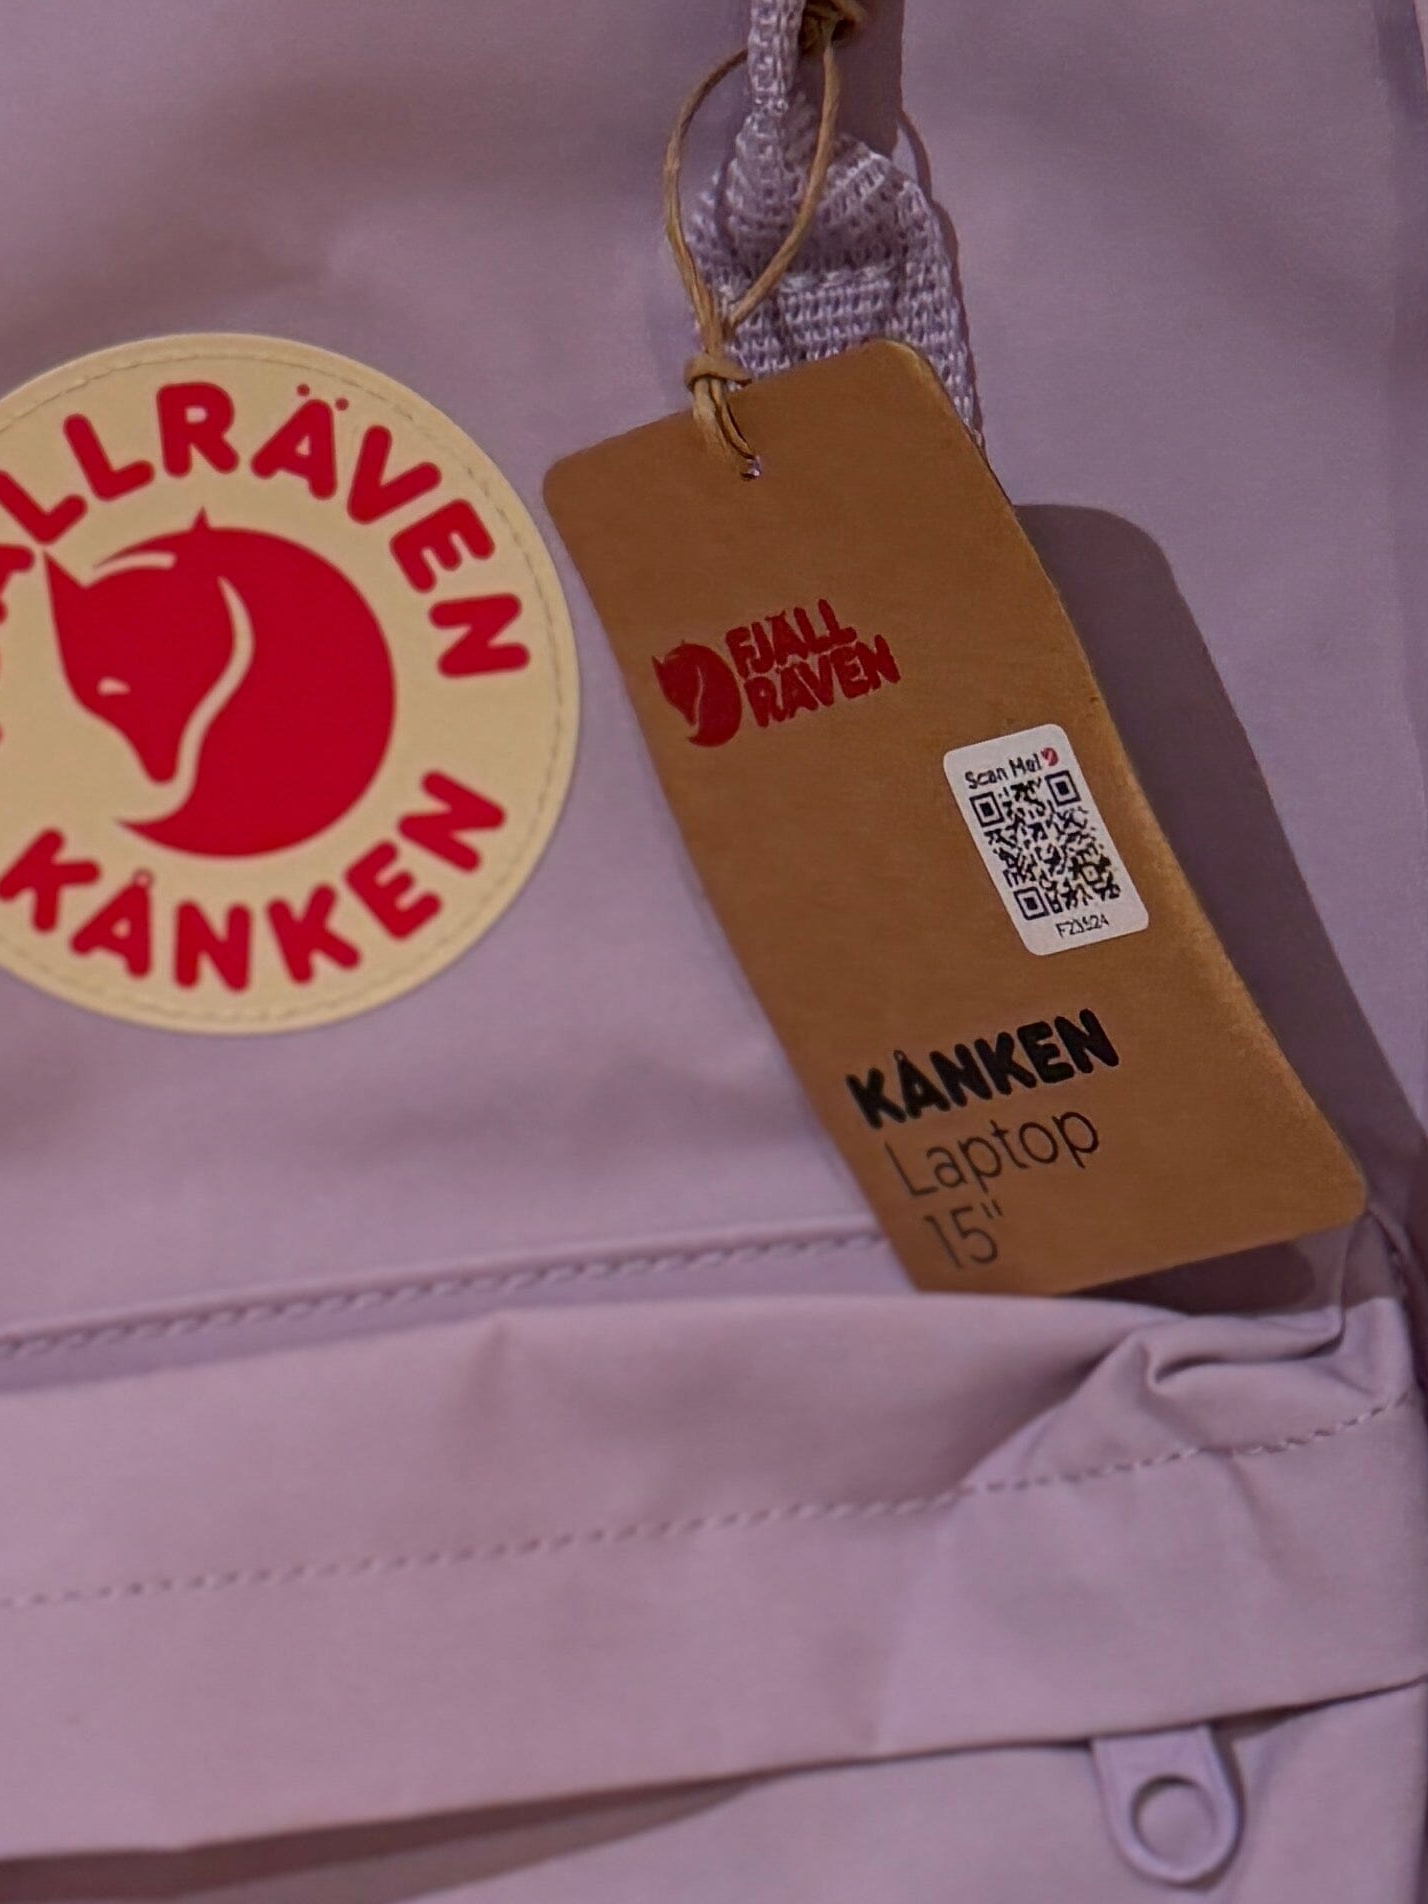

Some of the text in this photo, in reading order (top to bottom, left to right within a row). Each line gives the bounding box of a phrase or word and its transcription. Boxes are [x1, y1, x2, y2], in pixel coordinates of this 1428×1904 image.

[725, 598, 857, 679] FJÄLL
[743, 634, 901, 728] RÄVEN
[964, 767, 1009, 790] Scan
[845, 1008, 1120, 1130] KÅNKEN
[884, 1111, 1100, 1197] Laptop
[924, 1199, 1003, 1269] 15"
